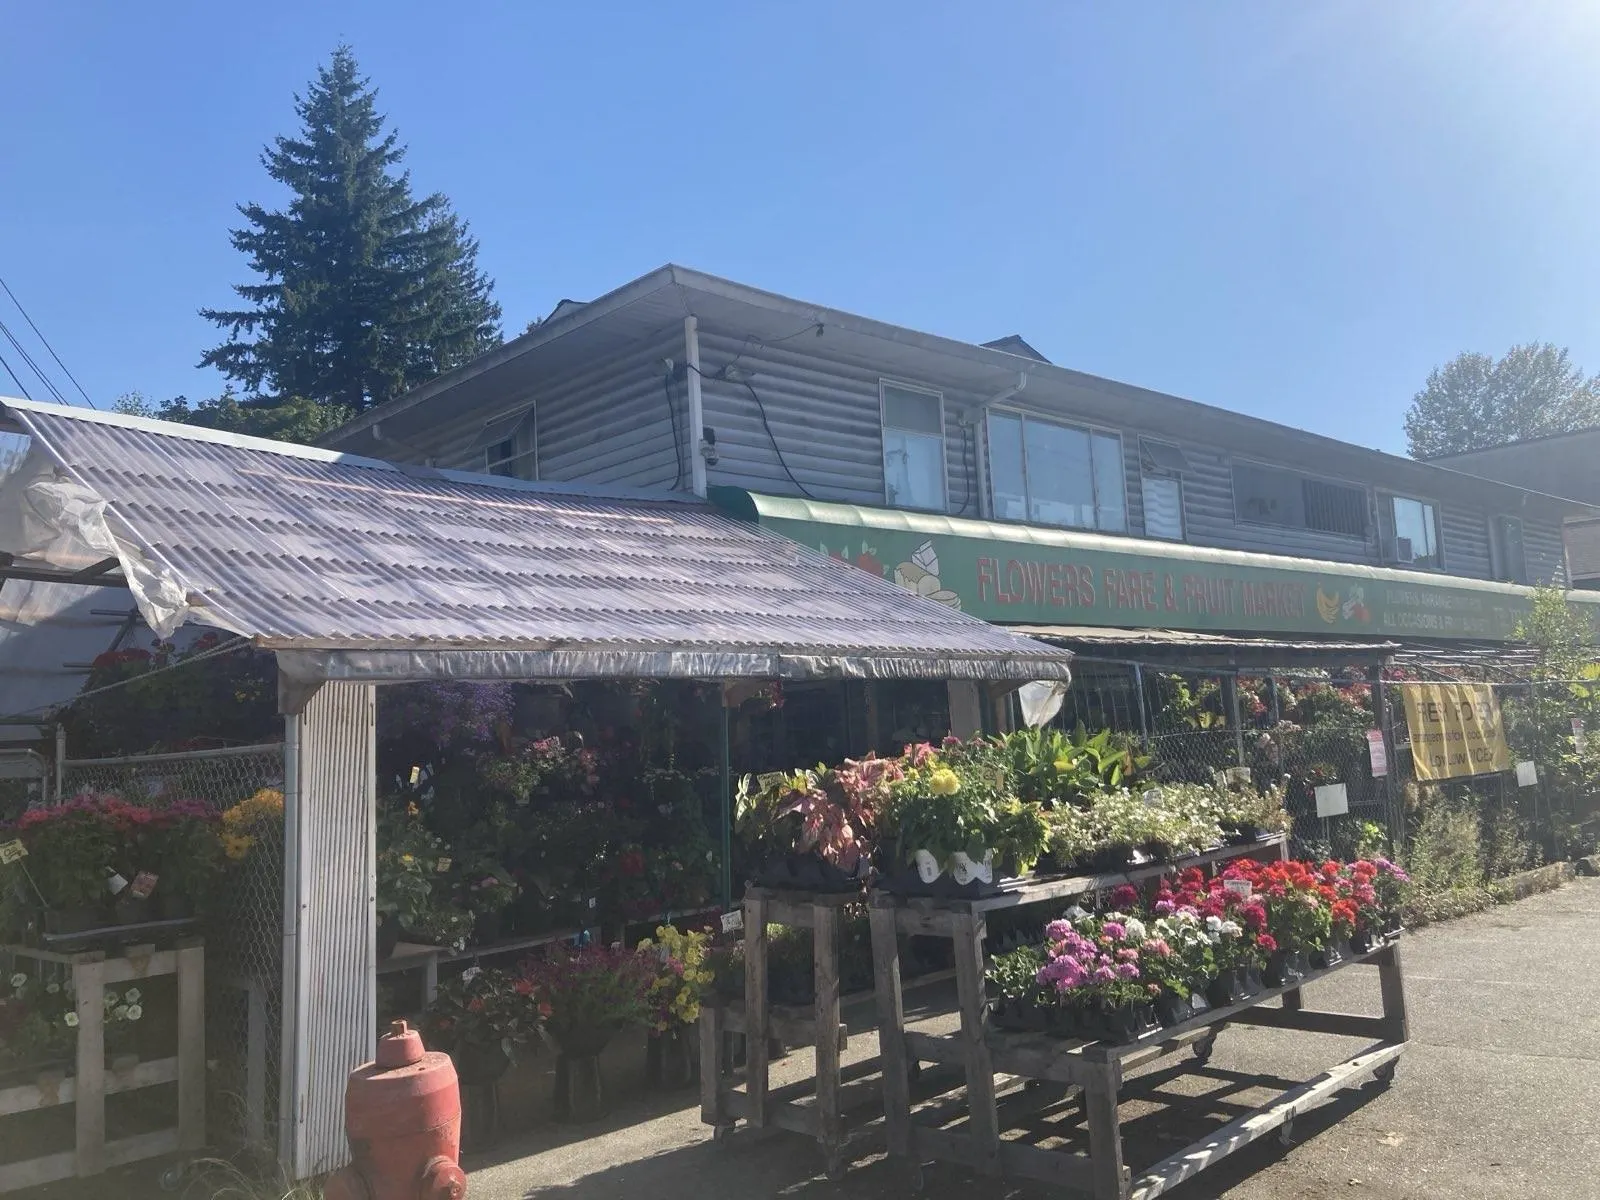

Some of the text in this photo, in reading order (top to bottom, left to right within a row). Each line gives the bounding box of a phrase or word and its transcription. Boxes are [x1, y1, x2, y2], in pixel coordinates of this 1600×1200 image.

[976, 557, 1306, 619] FLOWERS FARE & FRUIT MARKET
